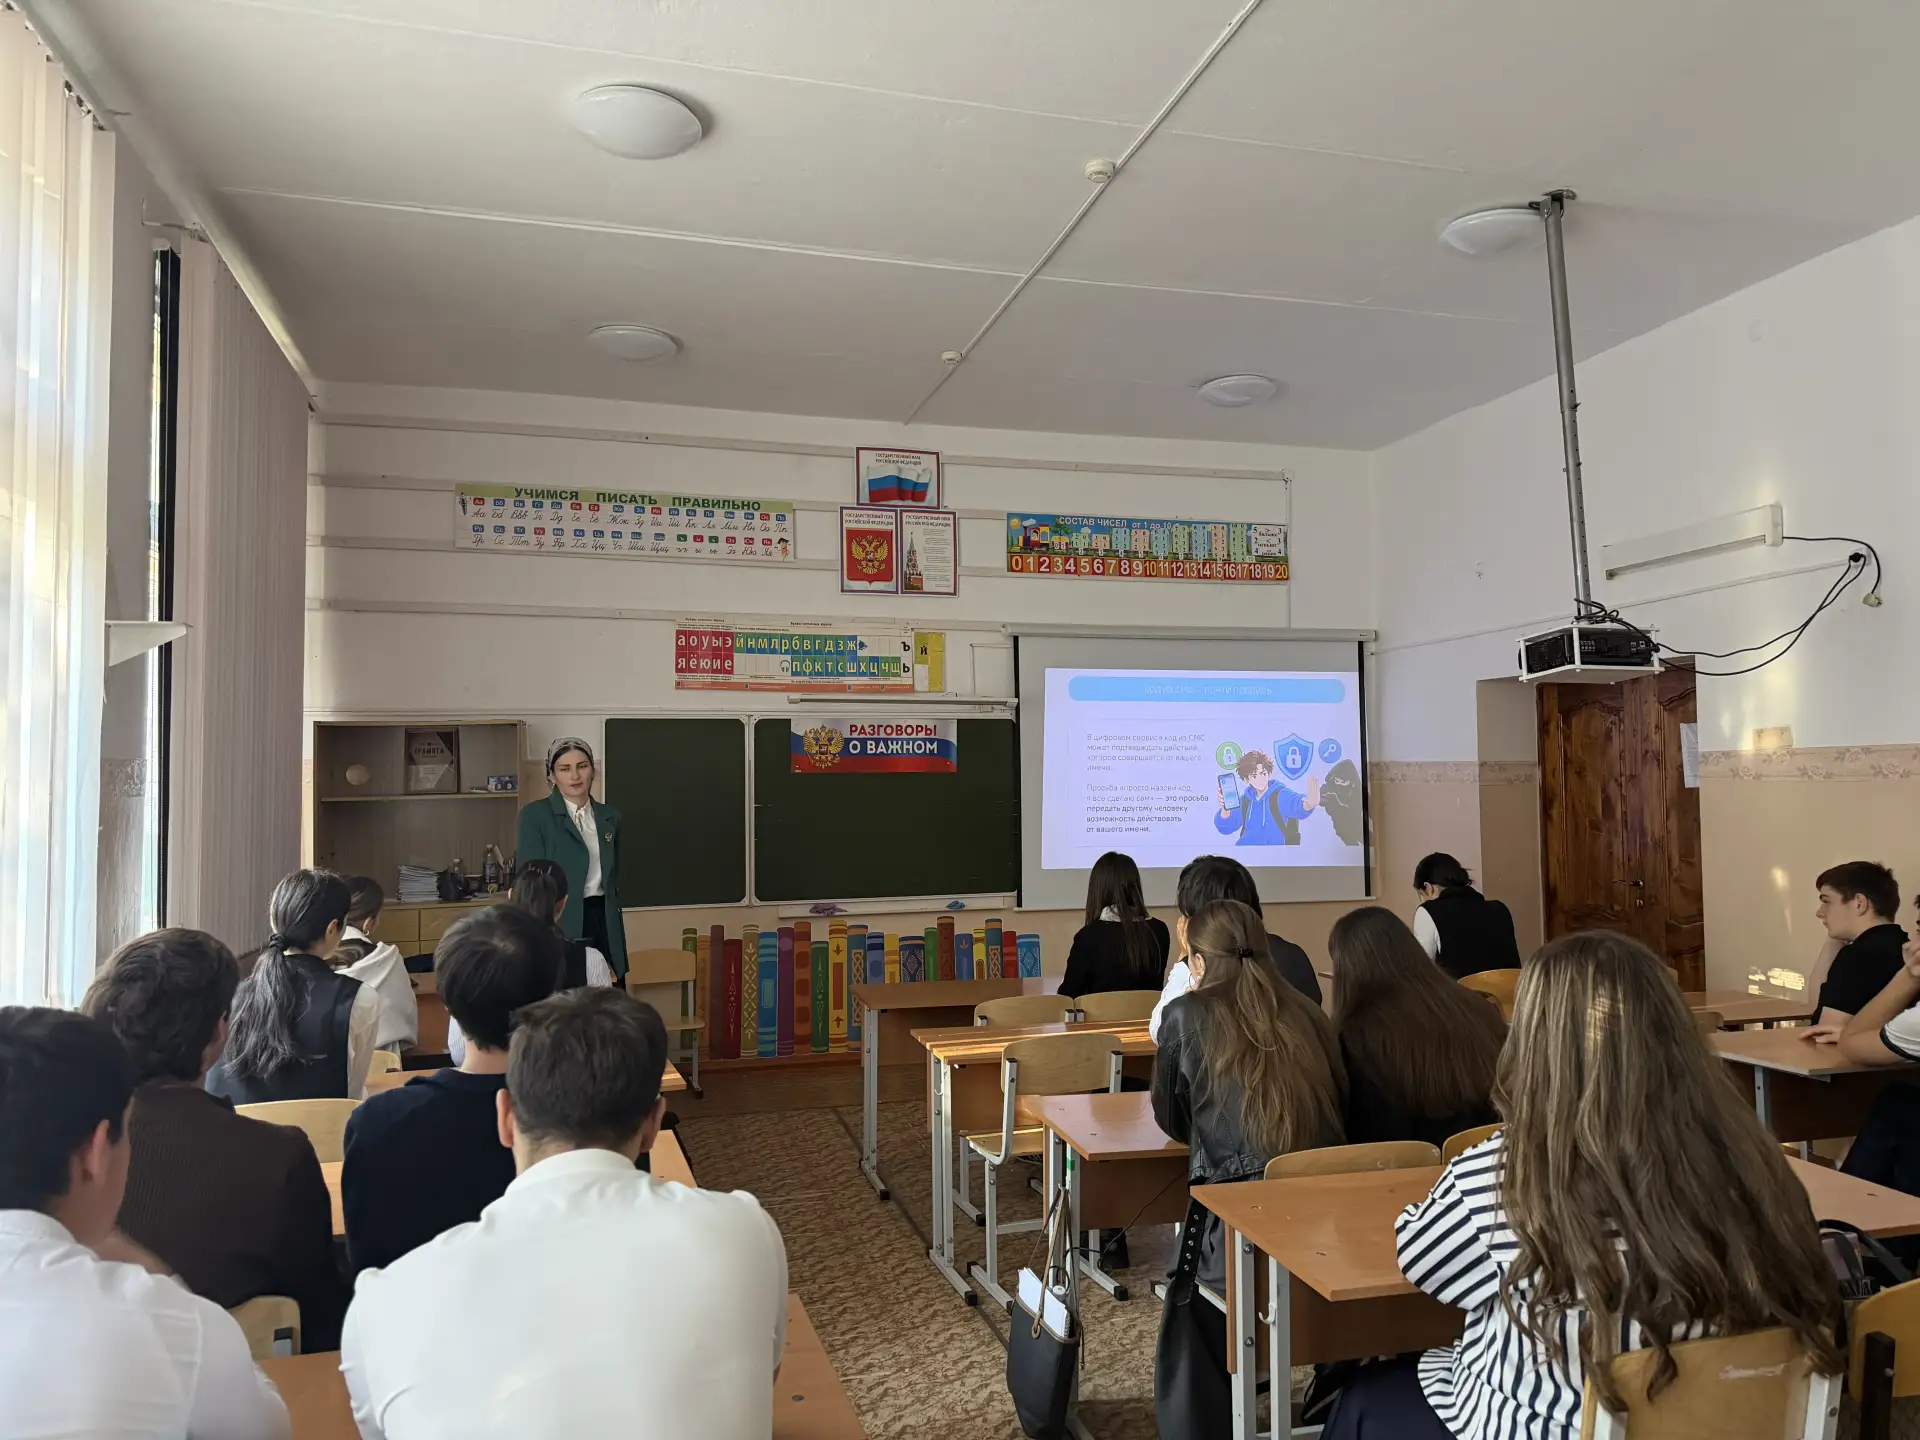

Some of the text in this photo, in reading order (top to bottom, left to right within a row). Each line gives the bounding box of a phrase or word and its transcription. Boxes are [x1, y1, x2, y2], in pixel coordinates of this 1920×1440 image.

[514, 488, 761, 511] УЧИМСЯ ПИСАТЬ ПРАВИЛЬНО
[1060, 517, 1095, 526] СОСТАВ
[1098, 518, 1127, 527] ЧИСЕЛ
[1012, 556, 1288, 578] 0 1 2 3 4 5 6 7 8 9 10 11 12 13 14 15 16 17 18 19 20
[849, 724, 937, 736] РАЗГОВОРЫ
[849, 740, 938, 754] О ВАЖНОМ
[1087, 784, 1118, 792] Просьба
[1137, 815, 1182, 823] действовать
